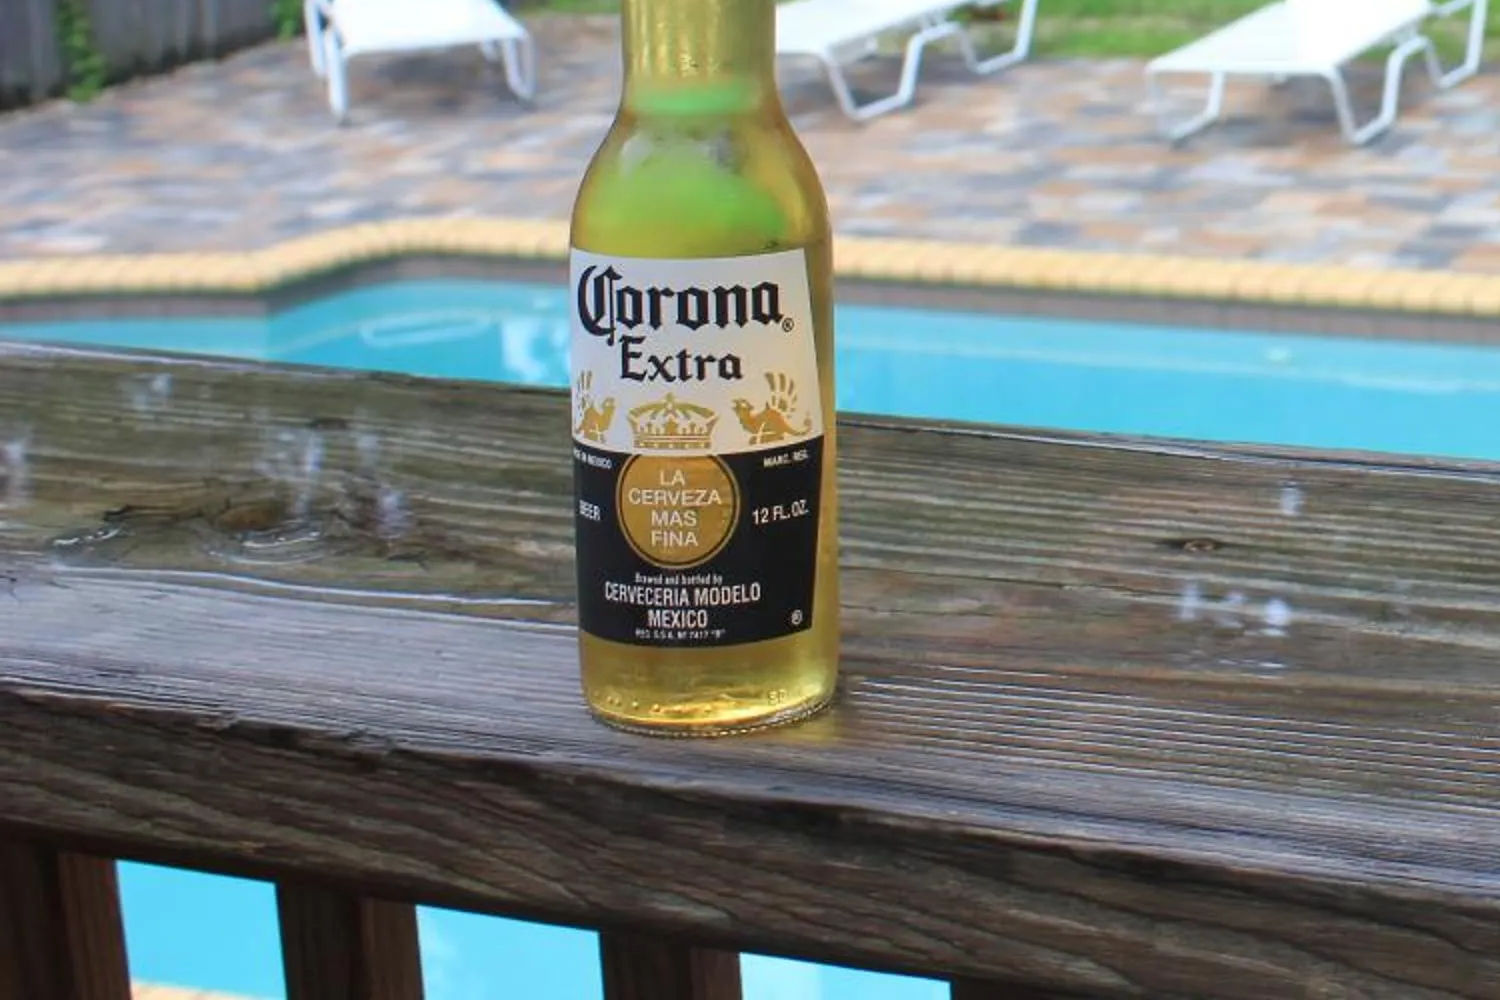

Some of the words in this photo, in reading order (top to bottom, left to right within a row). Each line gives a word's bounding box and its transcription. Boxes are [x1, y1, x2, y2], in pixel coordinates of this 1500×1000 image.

[577, 264, 784, 346] Corona
[620, 335, 743, 383] Extra
[660, 469, 686, 486] LA
[628, 488, 723, 507] CERVEZA
[651, 509, 698, 528] MAS
[752, 507, 769, 525] 12
[651, 530, 699, 548] FINA
[665, 574, 679, 585] and
[712, 573, 723, 585] by
[605, 581, 690, 607] CERVECERIA
[694, 582, 761, 606] MODELO
[647, 609, 709, 629] MEXICO
